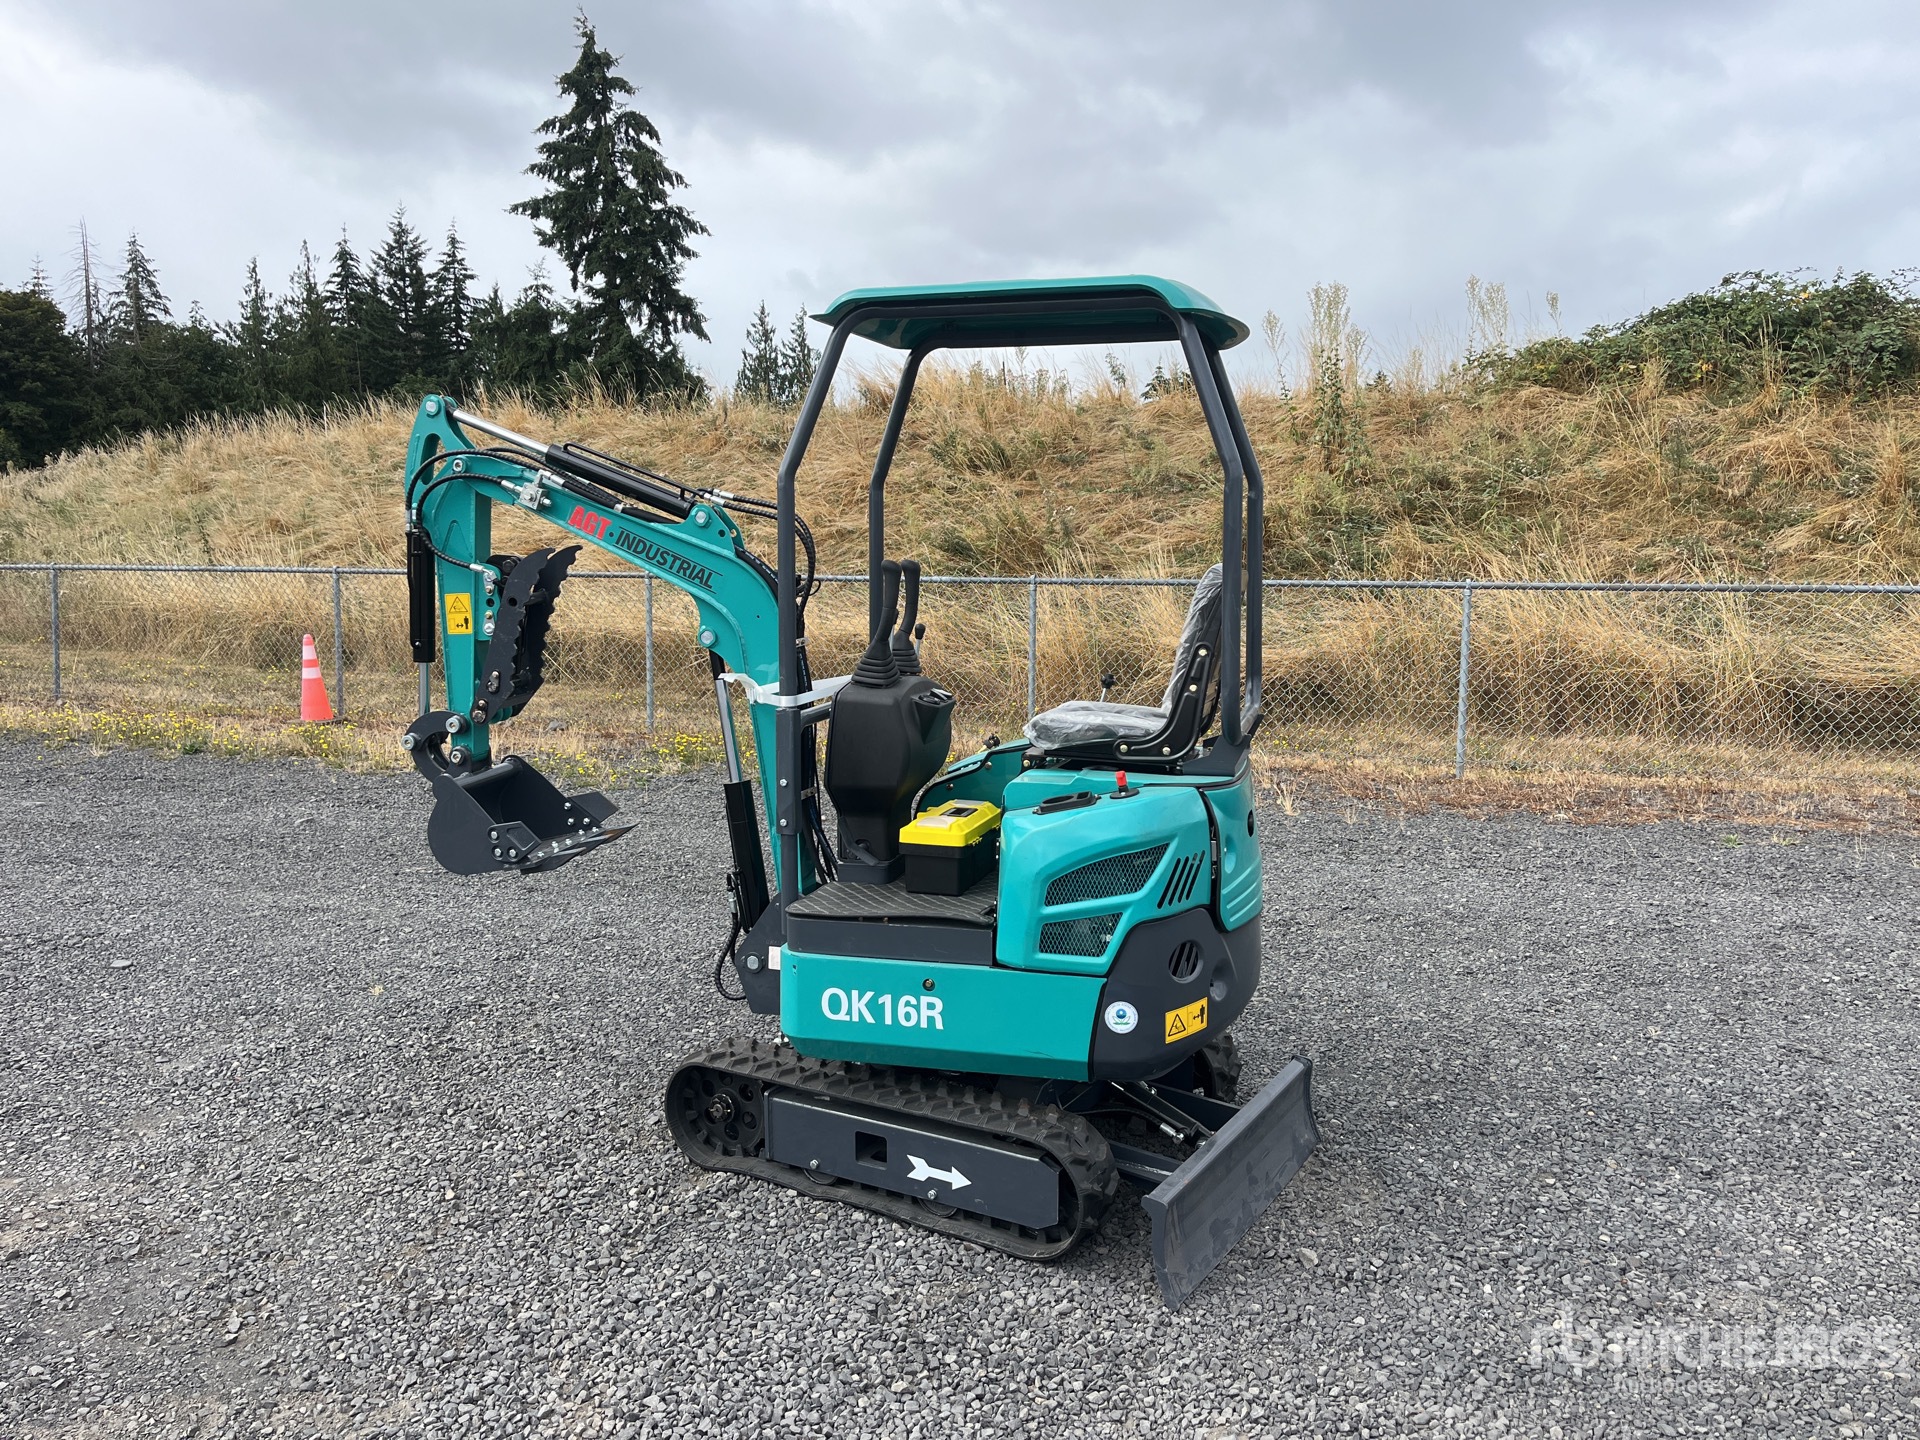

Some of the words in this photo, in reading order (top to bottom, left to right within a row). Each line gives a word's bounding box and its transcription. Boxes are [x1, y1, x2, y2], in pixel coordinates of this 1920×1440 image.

[568, 506, 612, 540] AGT
[615, 530, 713, 589] INDUSTRIAL
[821, 987, 944, 1030] QK16R
